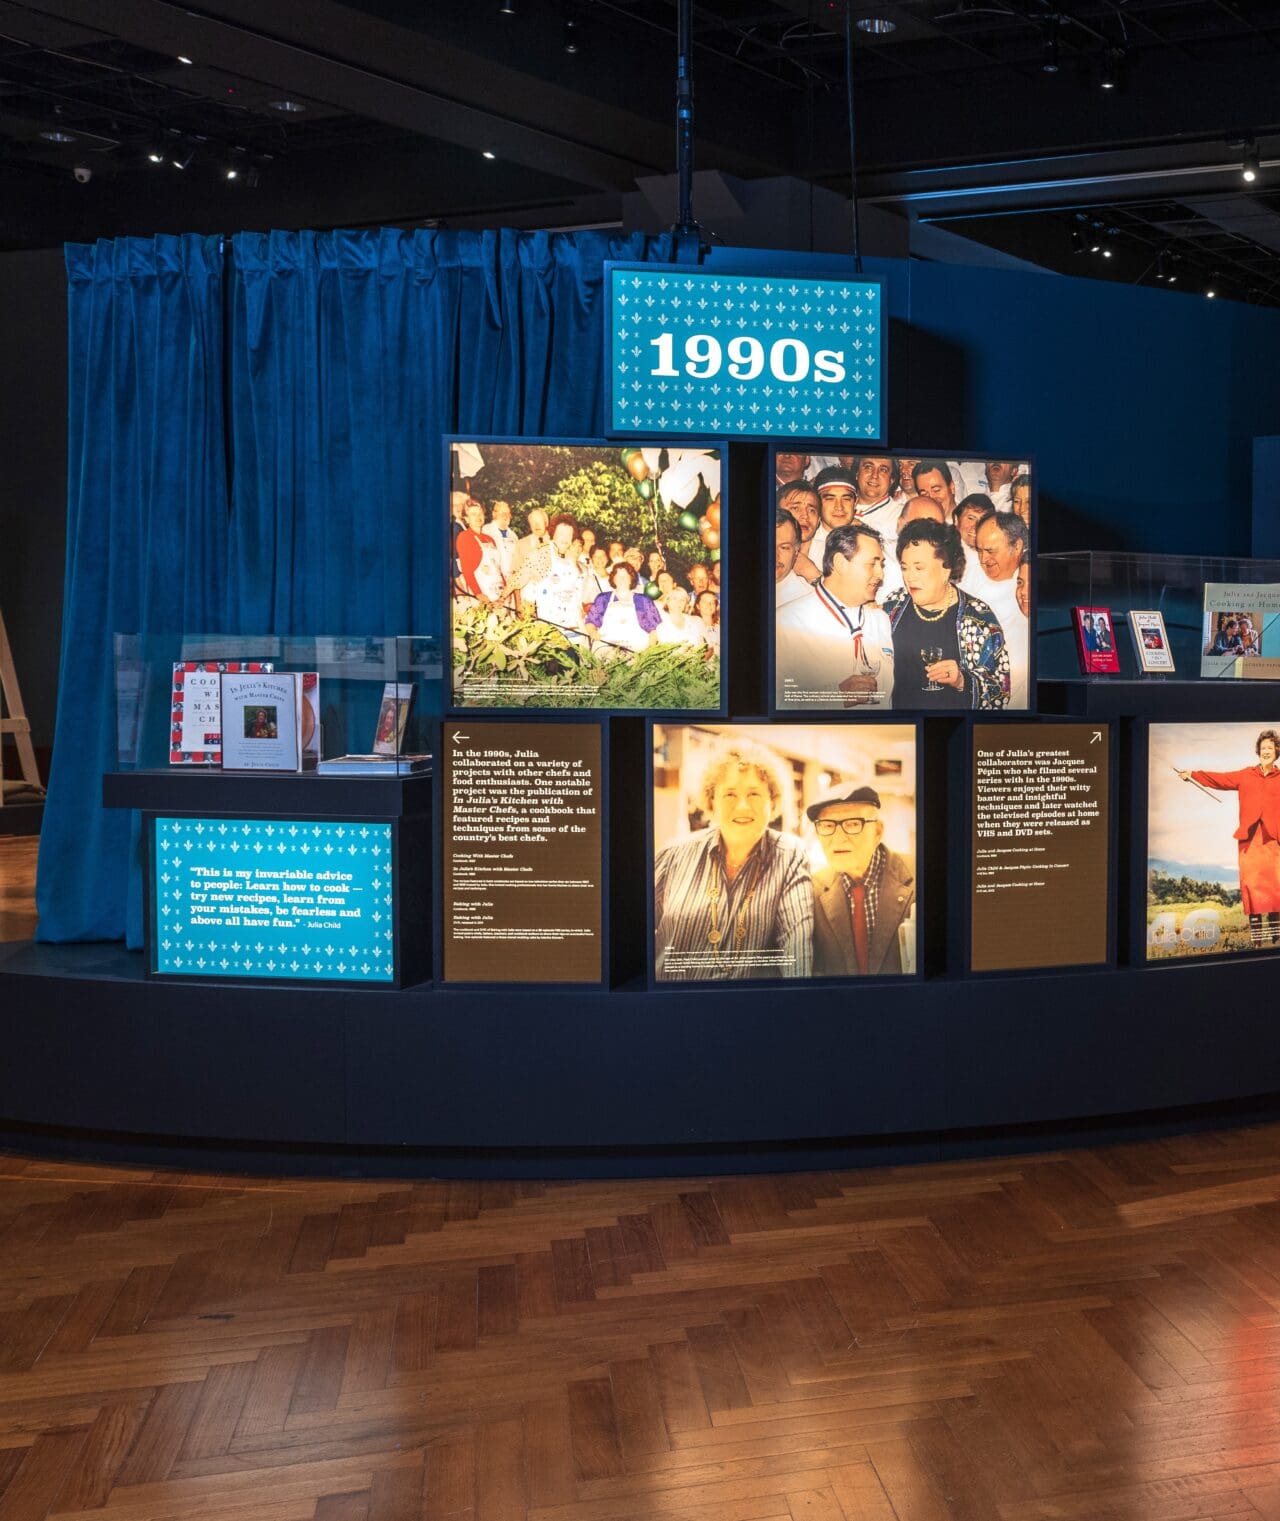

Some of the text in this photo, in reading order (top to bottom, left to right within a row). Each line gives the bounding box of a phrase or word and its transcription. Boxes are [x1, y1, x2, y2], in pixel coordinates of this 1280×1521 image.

[650, 332, 846, 383] 1990s
[1036, 750, 1069, 758] greatest
[453, 759, 510, 767] collaborated
[1052, 759, 1085, 767] Jacques
[453, 769, 490, 777] projects
[977, 768, 1001, 776] Pépin
[453, 788, 486, 796] project
[527, 788, 580, 796] publication
[1013, 785, 1044, 793] enjoyed
[1032, 811, 1065, 819] episodes
[453, 825, 504, 833] techniques
[223, 868, 232, 877] is
[236, 870, 252, 879] my
[256, 869, 313, 879] invariable
[316, 871, 352, 880] advice
[191, 880, 200, 888] to
[204, 881, 242, 891] people:
[246, 881, 279, 890] Learn
[283, 882, 305, 891] how
[323, 884, 349, 892] cook
[191, 892, 207, 902] try
[237, 895, 280, 904] recipes,
[284, 895, 313, 903] learn
[317, 895, 345, 904] from
[220, 905, 272, 915] mistakes,
[276, 906, 288, 915] be
[292, 907, 336, 916] fearless
[340, 908, 361, 917] and
[244, 918, 269, 926] have
